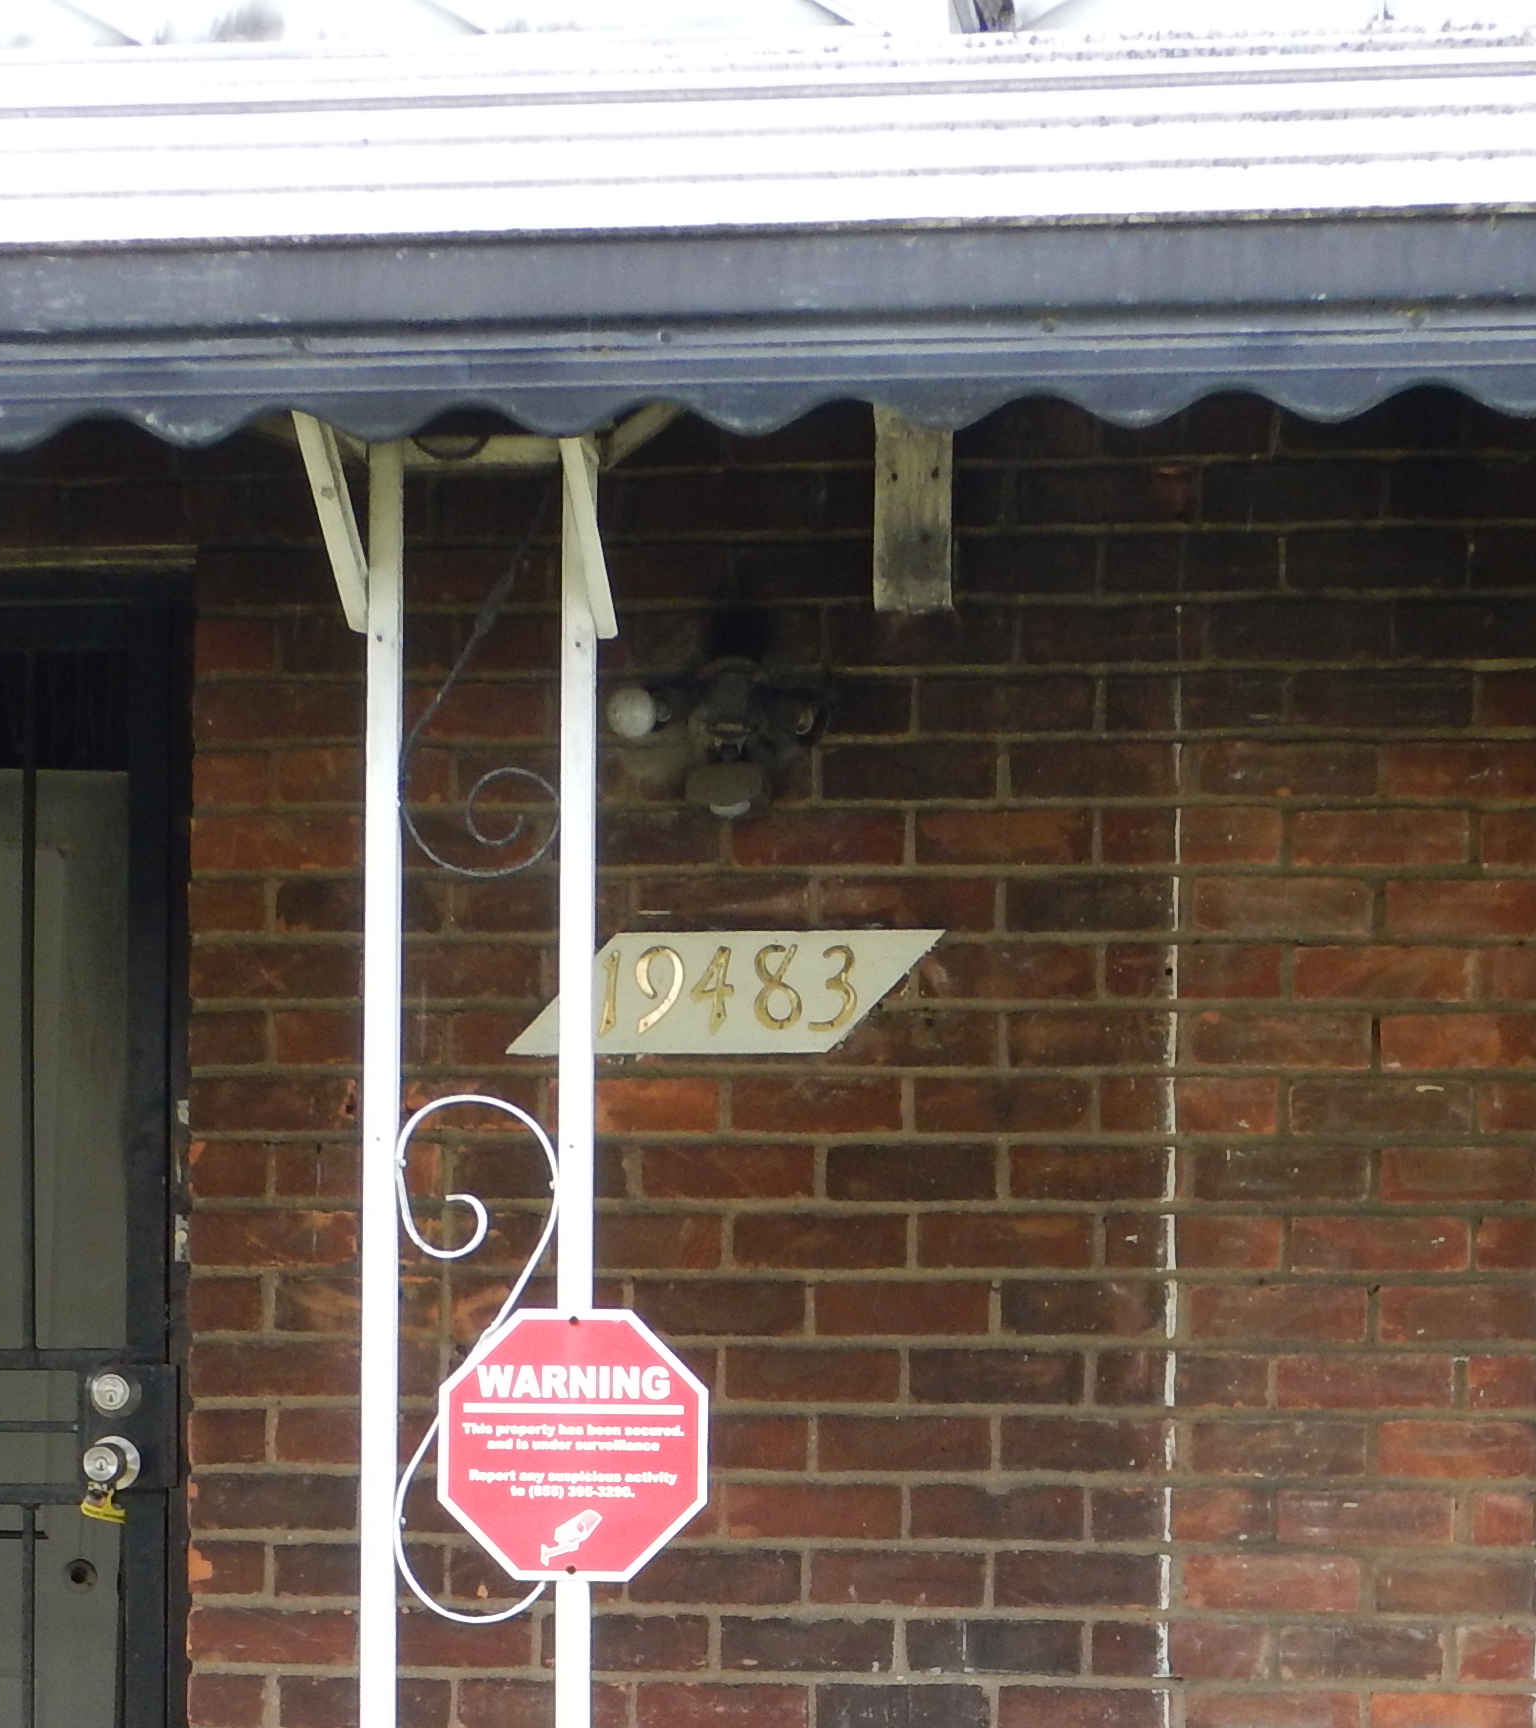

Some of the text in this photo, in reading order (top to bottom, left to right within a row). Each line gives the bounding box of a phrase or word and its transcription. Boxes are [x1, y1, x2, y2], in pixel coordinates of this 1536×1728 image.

[598, 945, 858, 1037] 19483
[477, 1365, 671, 1400] WARNING
[462, 1422, 685, 1437] This property has been secured.
[487, 1438, 660, 1452] and is under surveillance
[469, 1469, 677, 1485] Report any suspicious activity
[510, 1485, 525, 1497] to
